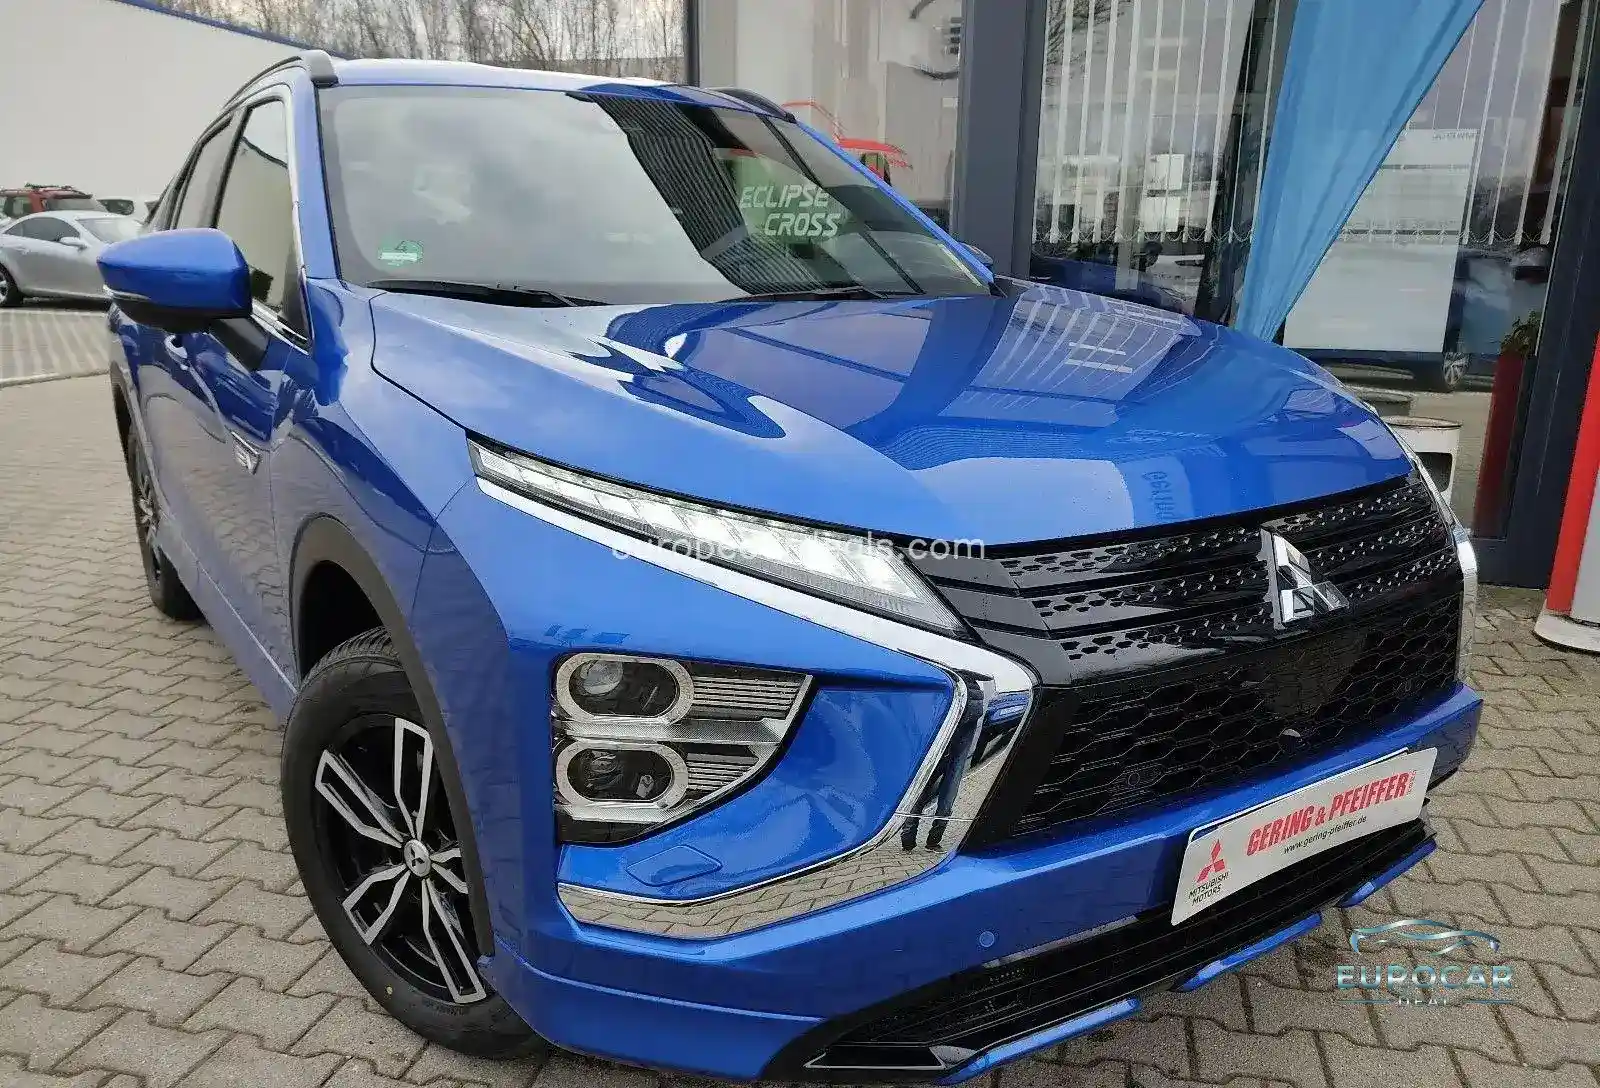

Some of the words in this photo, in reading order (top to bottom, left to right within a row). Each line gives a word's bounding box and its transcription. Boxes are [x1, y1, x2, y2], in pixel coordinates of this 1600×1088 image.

[740, 184, 830, 209] ECLIPSE
[764, 212, 841, 236] CROSS
[1246, 805, 1315, 856] GERING
[1315, 806, 1326, 827] &
[1328, 772, 1410, 821] PFEIFFER
[1283, 814, 1367, 854] www.gering-pfeiffer.de
[1188, 871, 1229, 899] MITSUBISHI
[1191, 884, 1222, 906] MOTORS
